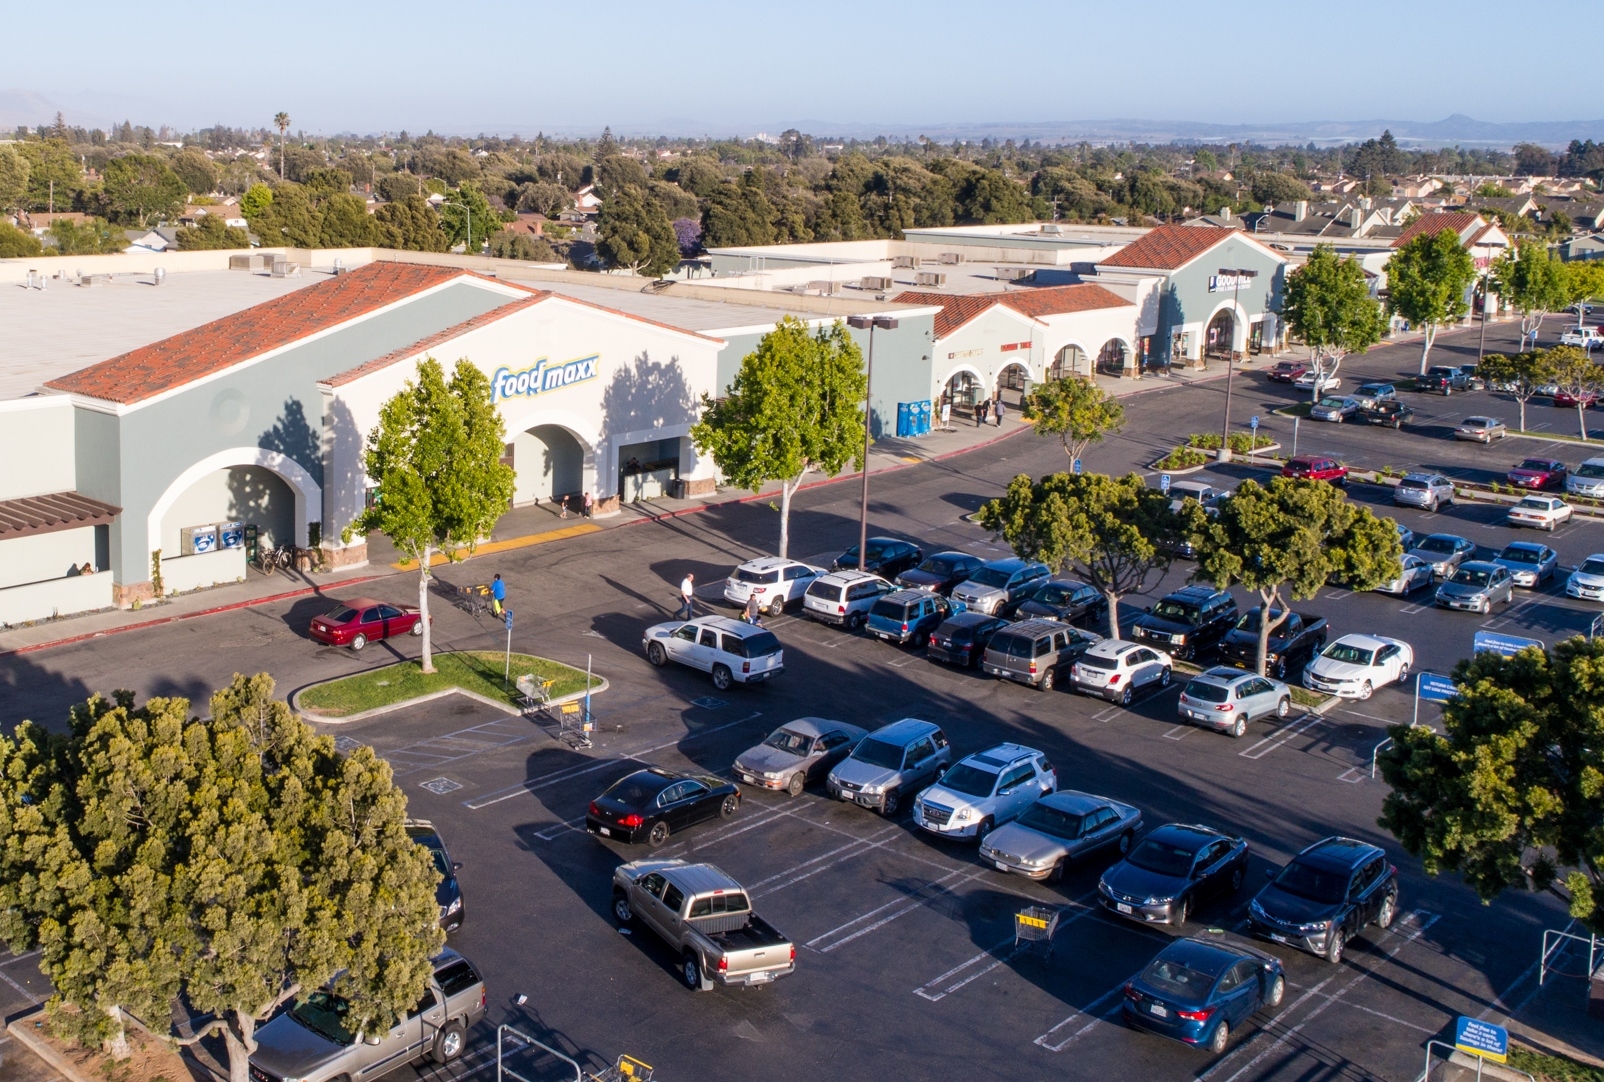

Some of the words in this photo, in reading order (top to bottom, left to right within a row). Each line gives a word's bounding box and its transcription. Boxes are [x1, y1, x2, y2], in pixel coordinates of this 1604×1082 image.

[1463, 1031, 1480, 1040] there's
[1459, 1035, 1480, 1046] Savings
[1486, 1044, 1503, 1053] there!
